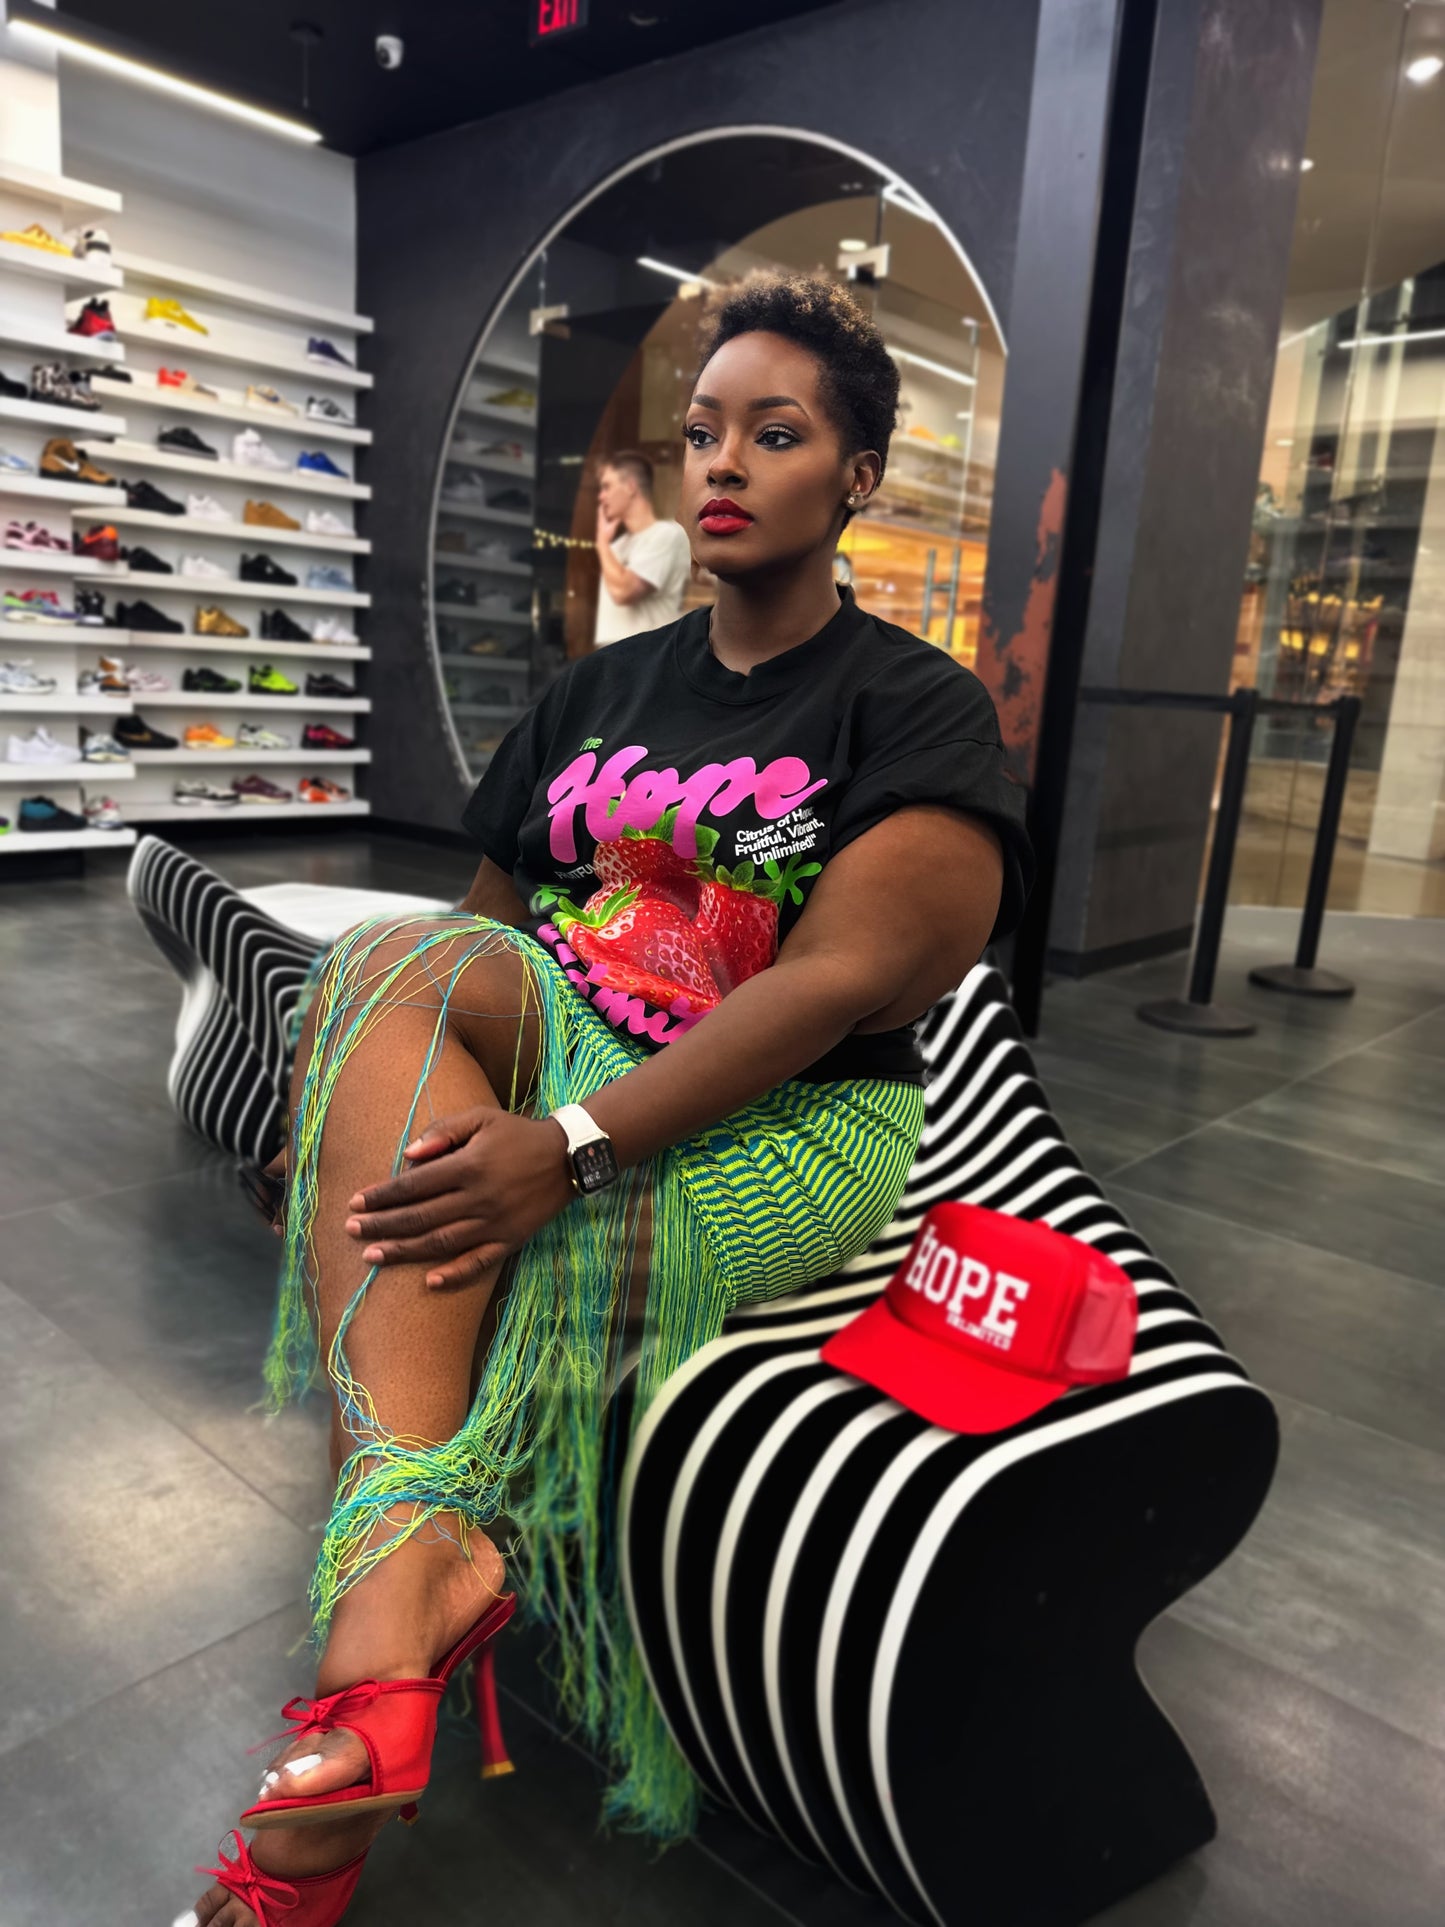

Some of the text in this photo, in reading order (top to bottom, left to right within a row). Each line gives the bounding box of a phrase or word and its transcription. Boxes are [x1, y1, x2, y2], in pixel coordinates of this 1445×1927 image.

[547, 745, 828, 864] Hope
[736, 824, 775, 843] Citrus
[776, 814, 791, 828] of
[735, 830, 786, 856] Fruitful,
[905, 1224, 1030, 1339] HOPE
